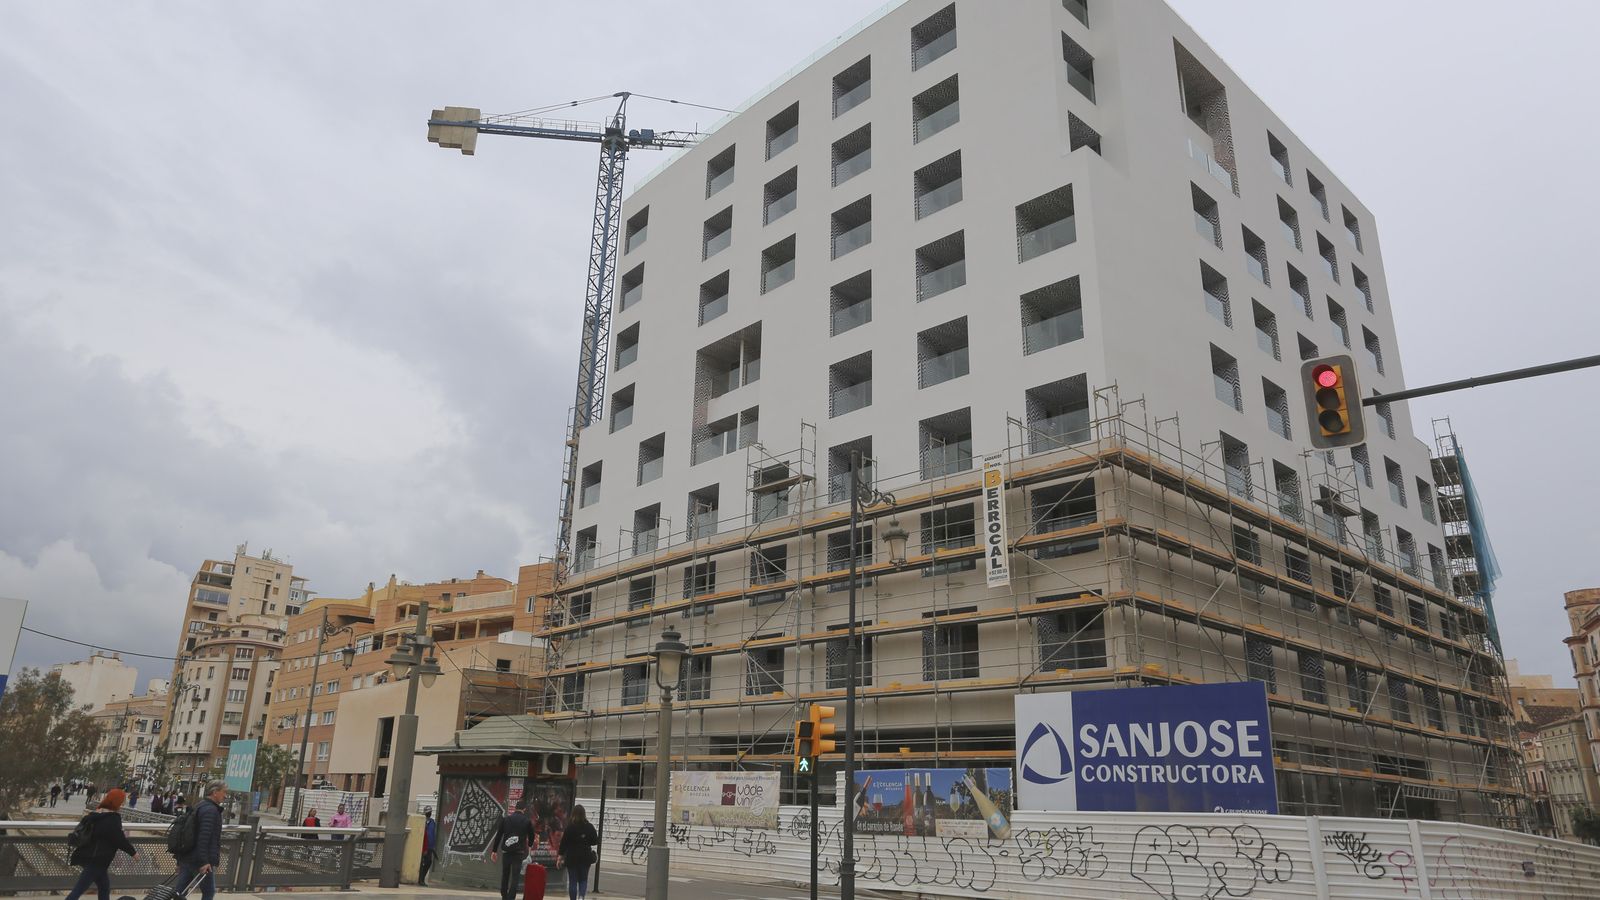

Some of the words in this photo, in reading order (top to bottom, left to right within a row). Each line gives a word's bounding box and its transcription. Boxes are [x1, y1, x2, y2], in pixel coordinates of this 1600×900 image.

[984, 469, 1003, 570] BERROCAL
[1079, 719, 1262, 759] SANJOSE
[1081, 764, 1265, 784] CONSTRUCTORA
